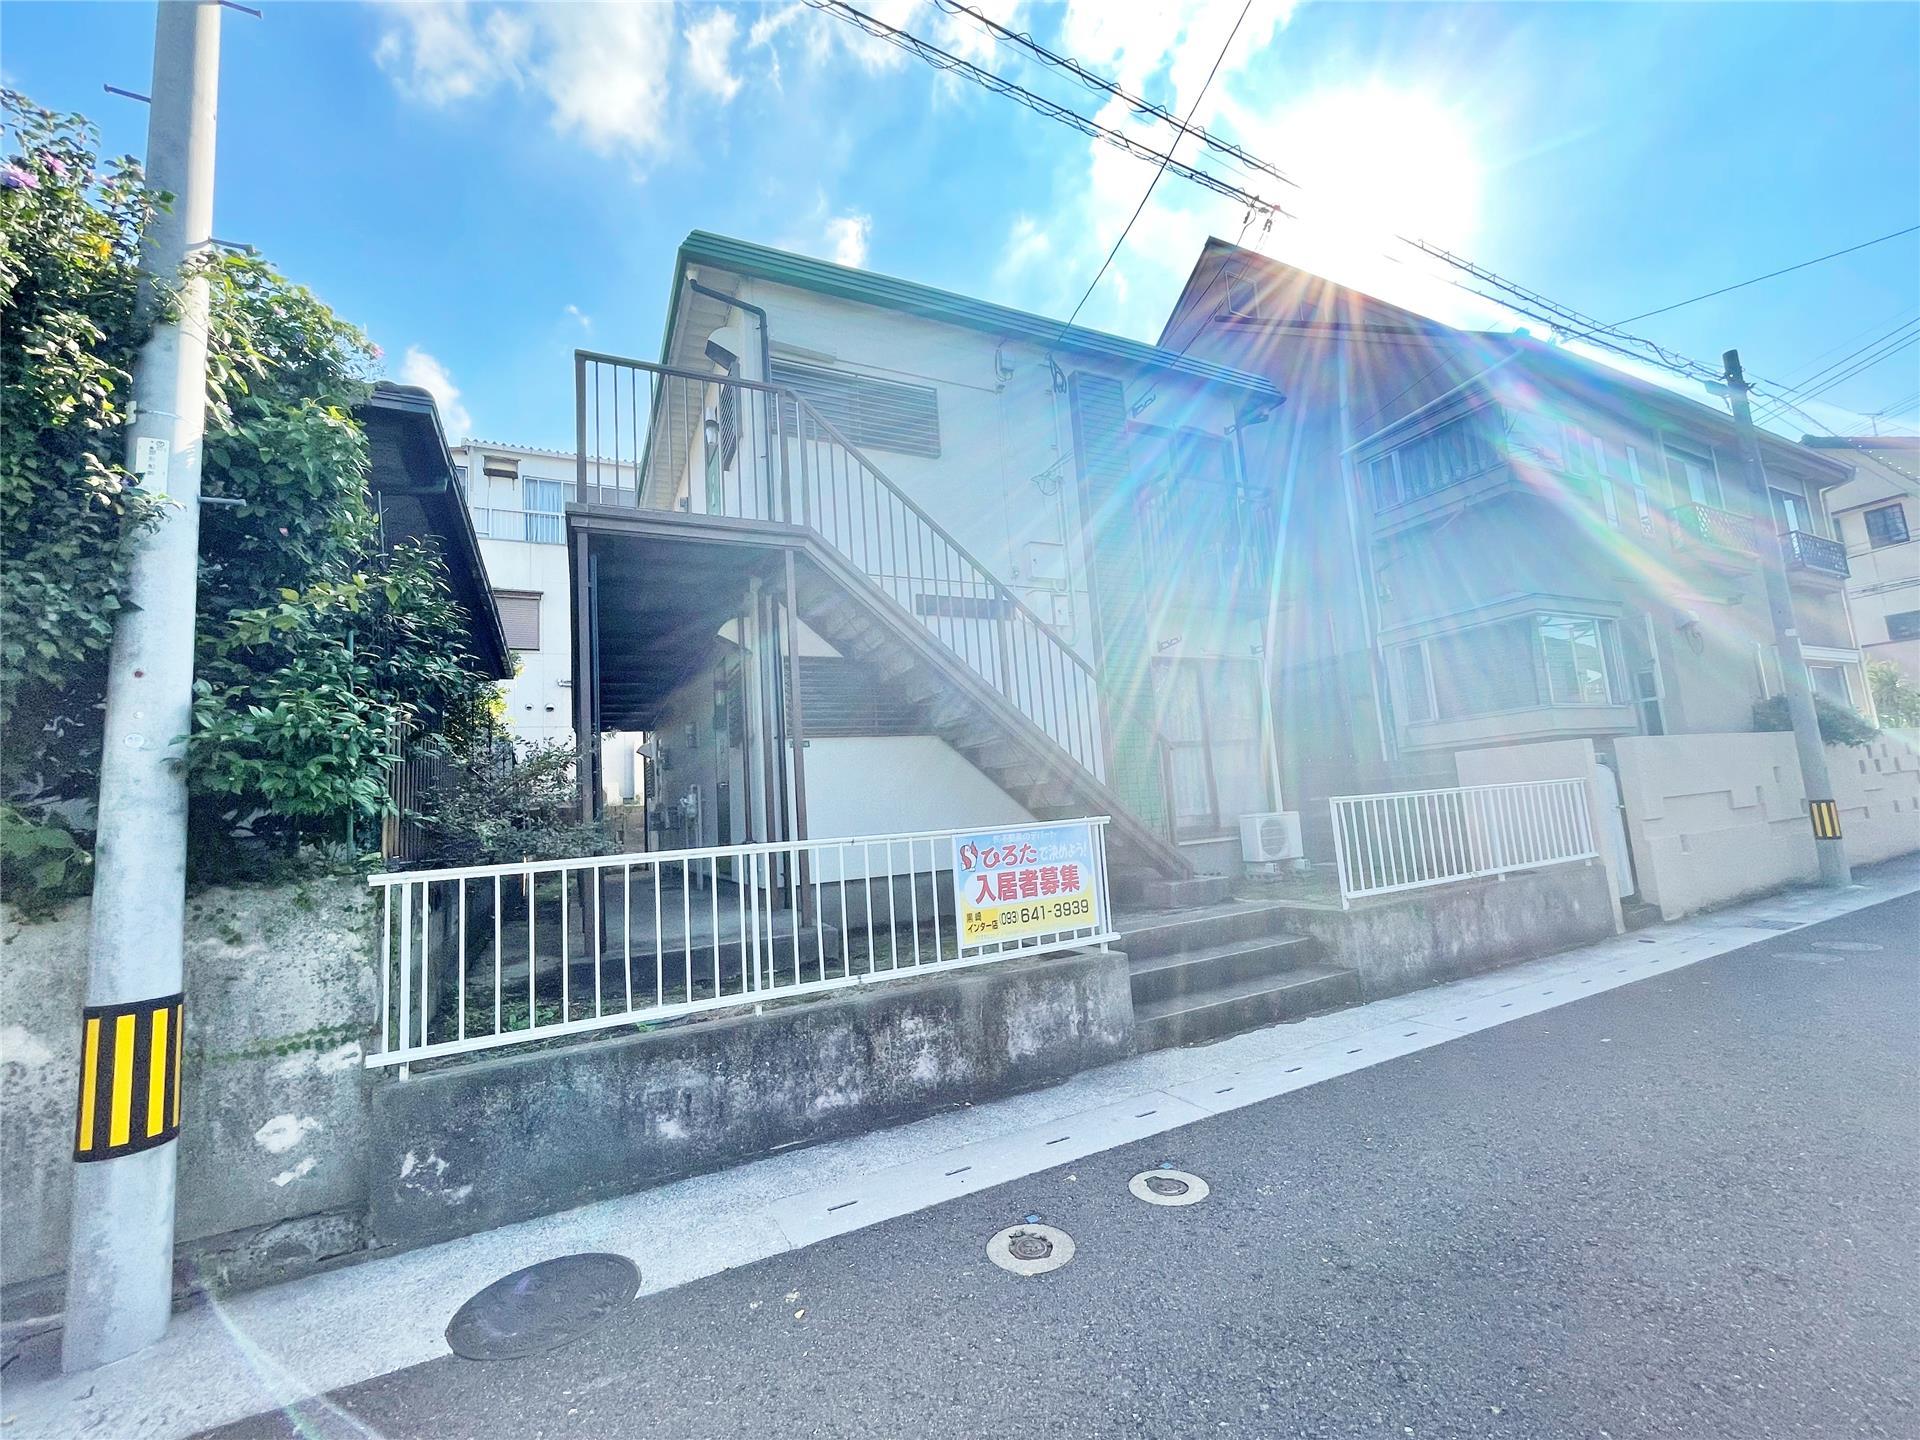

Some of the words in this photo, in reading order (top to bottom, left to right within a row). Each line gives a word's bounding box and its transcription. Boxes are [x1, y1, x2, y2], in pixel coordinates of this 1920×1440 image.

[980, 843, 1038, 869] ひろた
[975, 864, 1081, 905] 入居者募集
[1021, 899, 1089, 923] 641-3939
[967, 919, 999, 933] インター店
